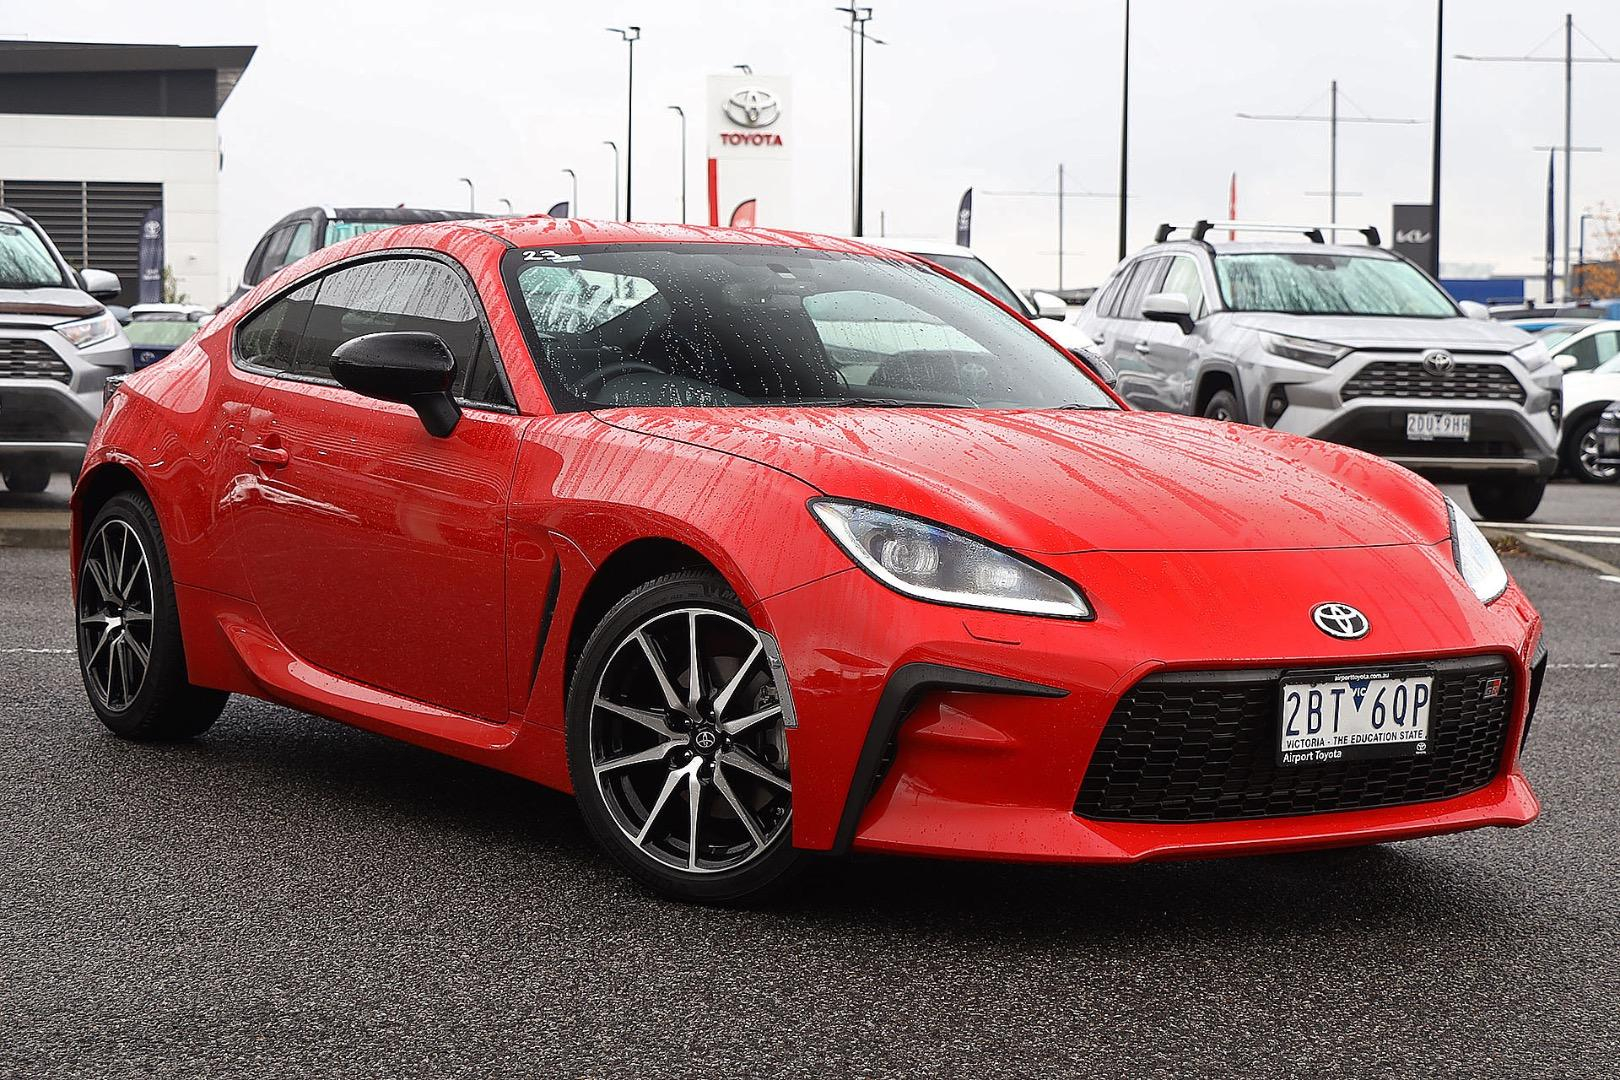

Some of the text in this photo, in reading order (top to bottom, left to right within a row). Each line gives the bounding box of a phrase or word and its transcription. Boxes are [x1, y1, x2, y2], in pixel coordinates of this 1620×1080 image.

[720, 133, 783, 146] TOYOTA
[1351, 687, 1367, 697] VIC
[1285, 683, 1429, 737] 2BT 6QP
[1286, 737, 1325, 749] VICTORIA
[1333, 735, 1348, 745] THE
[1351, 732, 1397, 744] EDUCATION
[1400, 730, 1423, 740] STATE
[1283, 749, 1342, 764] Airport Toyota
